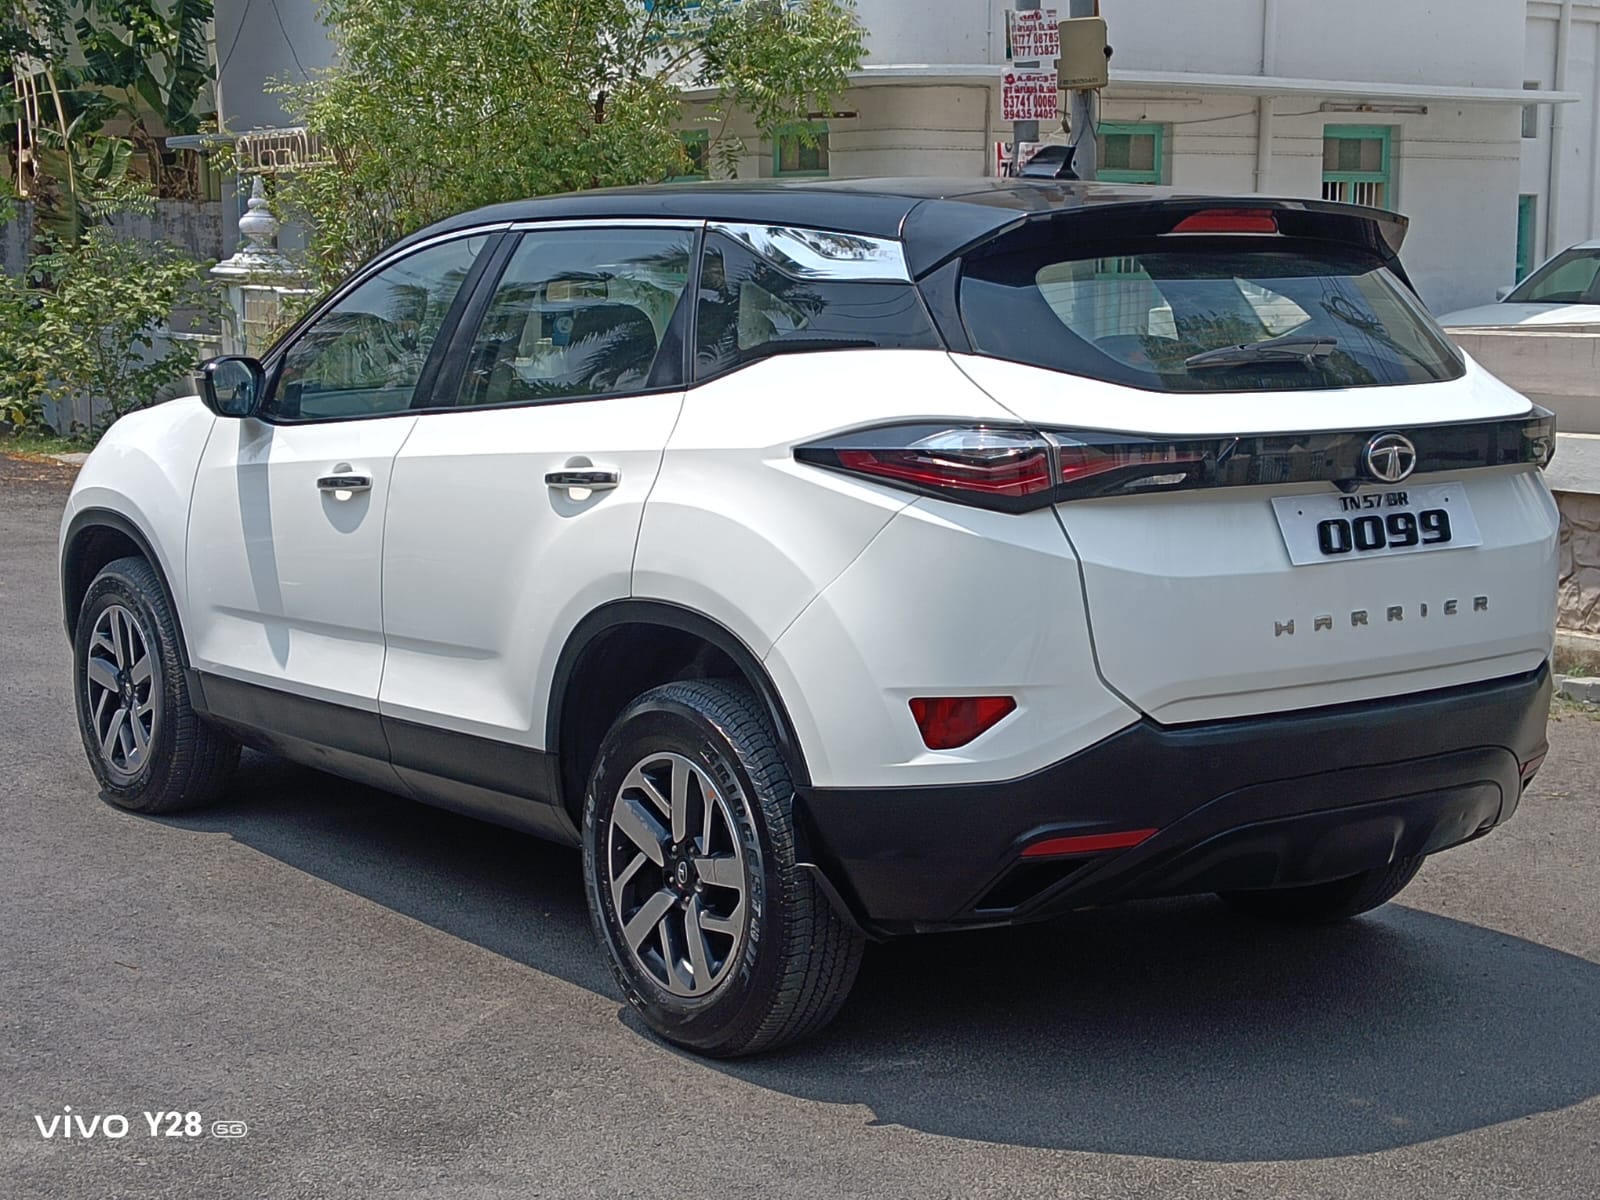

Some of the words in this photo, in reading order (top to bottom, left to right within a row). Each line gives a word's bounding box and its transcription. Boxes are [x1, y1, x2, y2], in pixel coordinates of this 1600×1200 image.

[1034, 44, 1059, 56] 03827
[1003, 95, 1031, 108] 63741
[1033, 95, 1057, 108] 00060
[1003, 109, 1032, 119] 99435
[1033, 108, 1057, 119] 44051
[1339, 496, 1361, 511] TN
[1362, 494, 1382, 509] 57
[1386, 491, 1409, 507] BR
[1318, 508, 1452, 555] 0099
[1274, 596, 1489, 637] HARRIER
